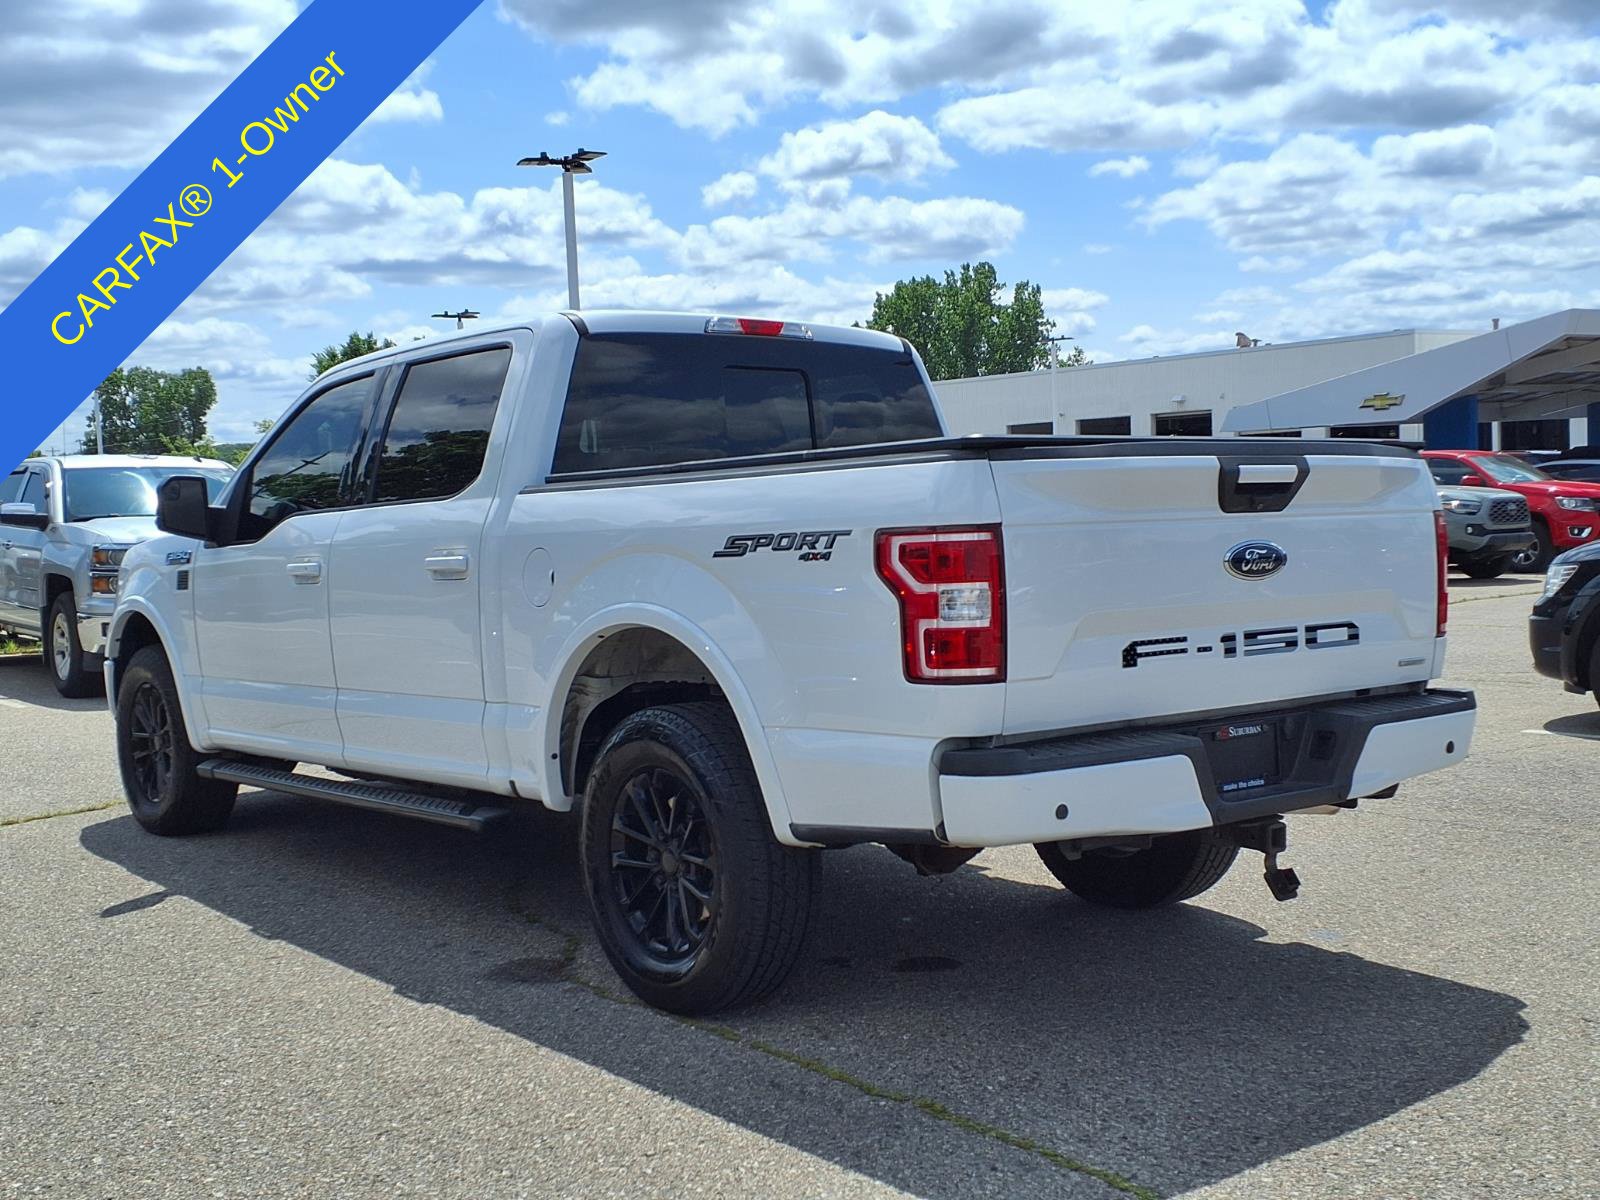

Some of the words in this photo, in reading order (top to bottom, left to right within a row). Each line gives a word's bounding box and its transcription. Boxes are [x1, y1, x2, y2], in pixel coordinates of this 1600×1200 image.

[713, 529, 852, 558] SPORT
[1242, 548, 1276, 571] Ford
[1122, 620, 1360, 668] F-150
[1228, 725, 1262, 737] SUBURBAN
